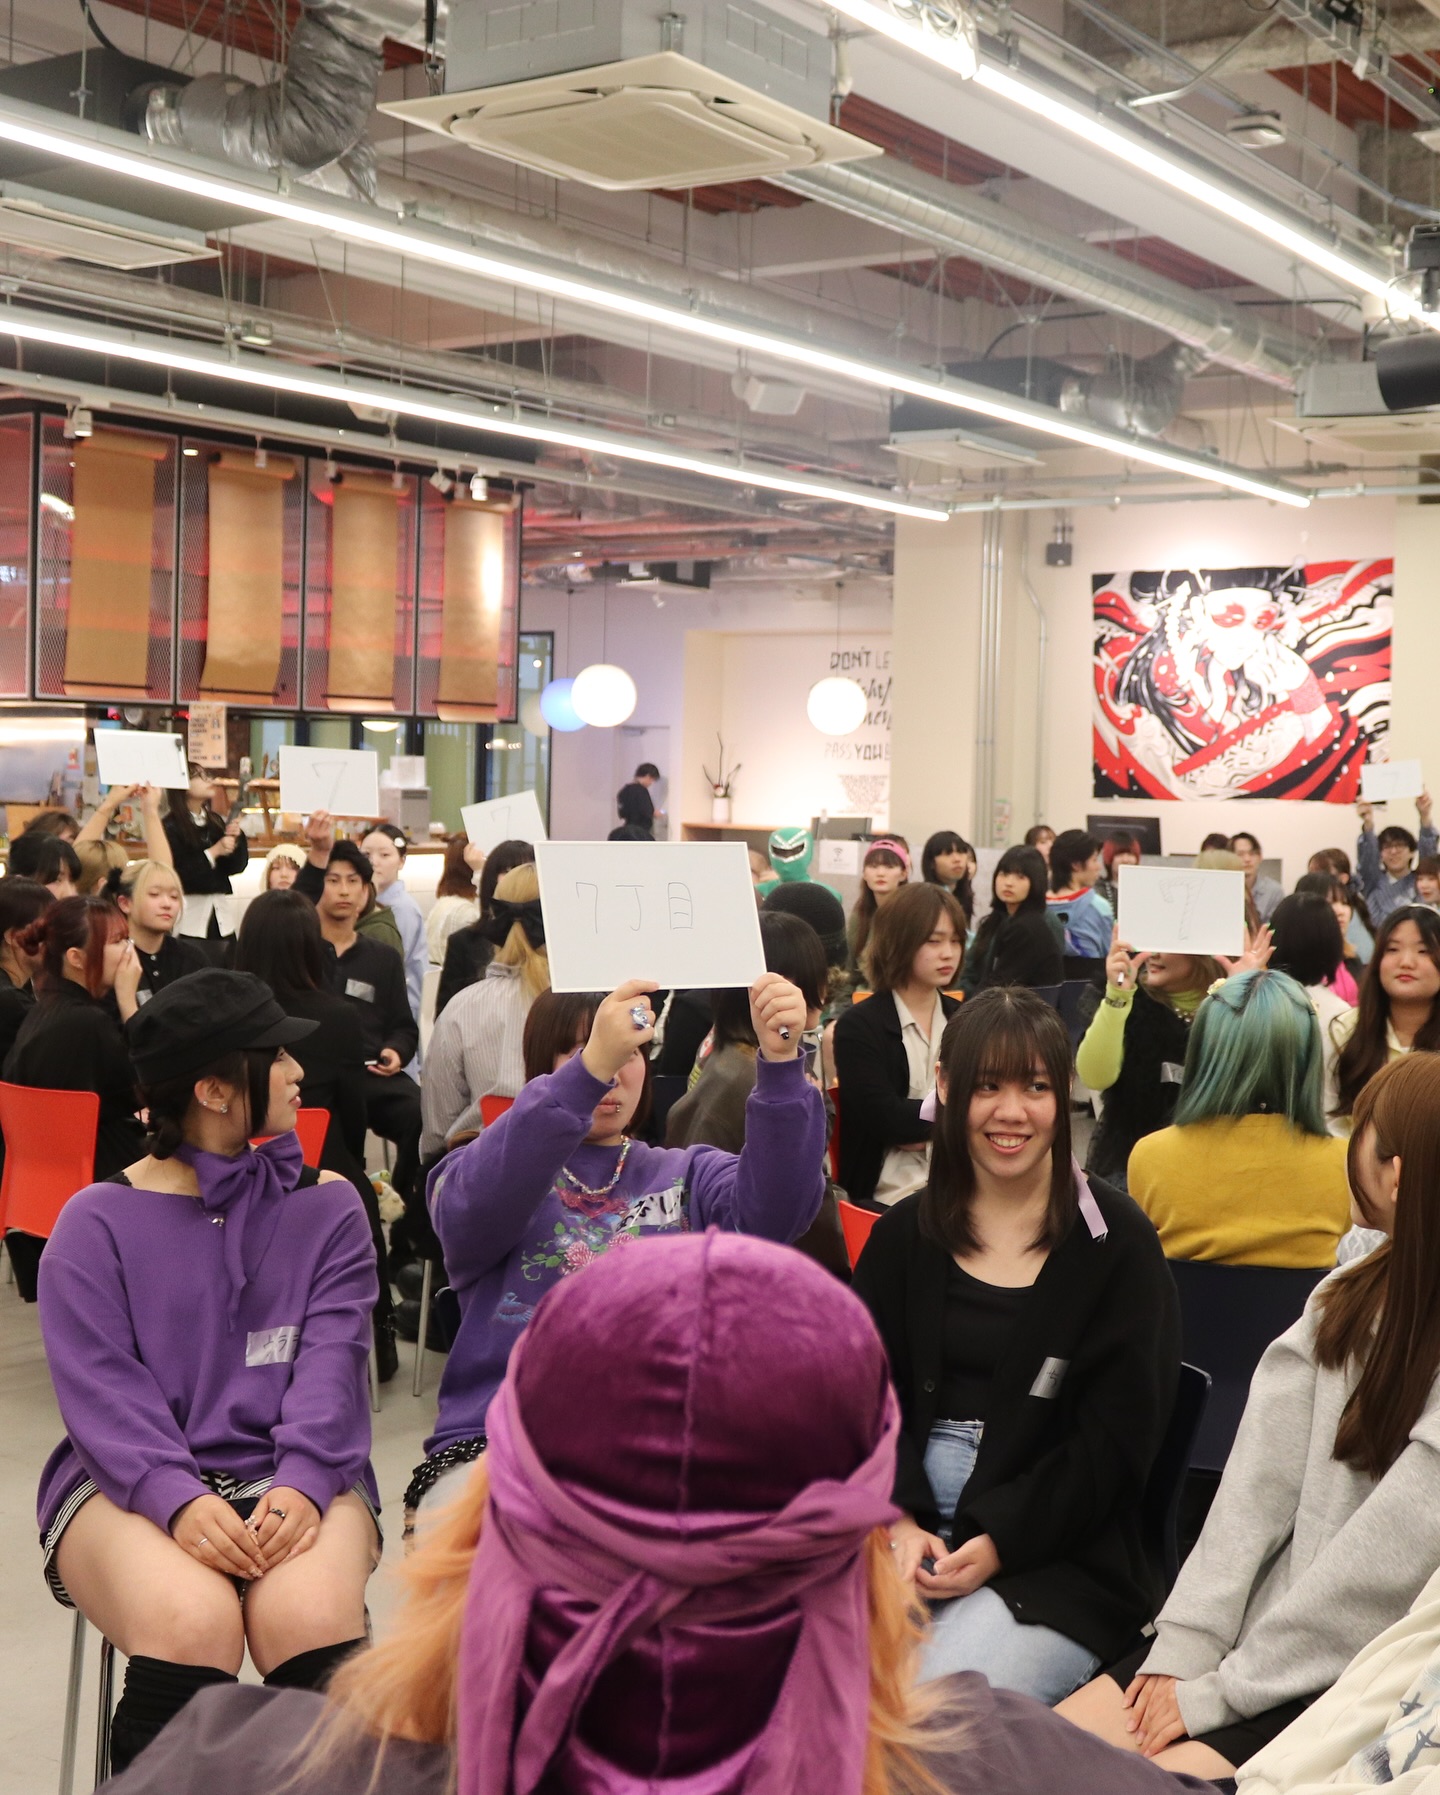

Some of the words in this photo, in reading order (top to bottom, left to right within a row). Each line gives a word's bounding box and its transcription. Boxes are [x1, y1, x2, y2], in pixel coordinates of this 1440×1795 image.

[829, 646, 871, 671] DON'T
[312, 761, 348, 810] 7
[490, 805, 511, 841] 7
[575, 881, 694, 935] 7丁目
[1159, 876, 1206, 942] 7
